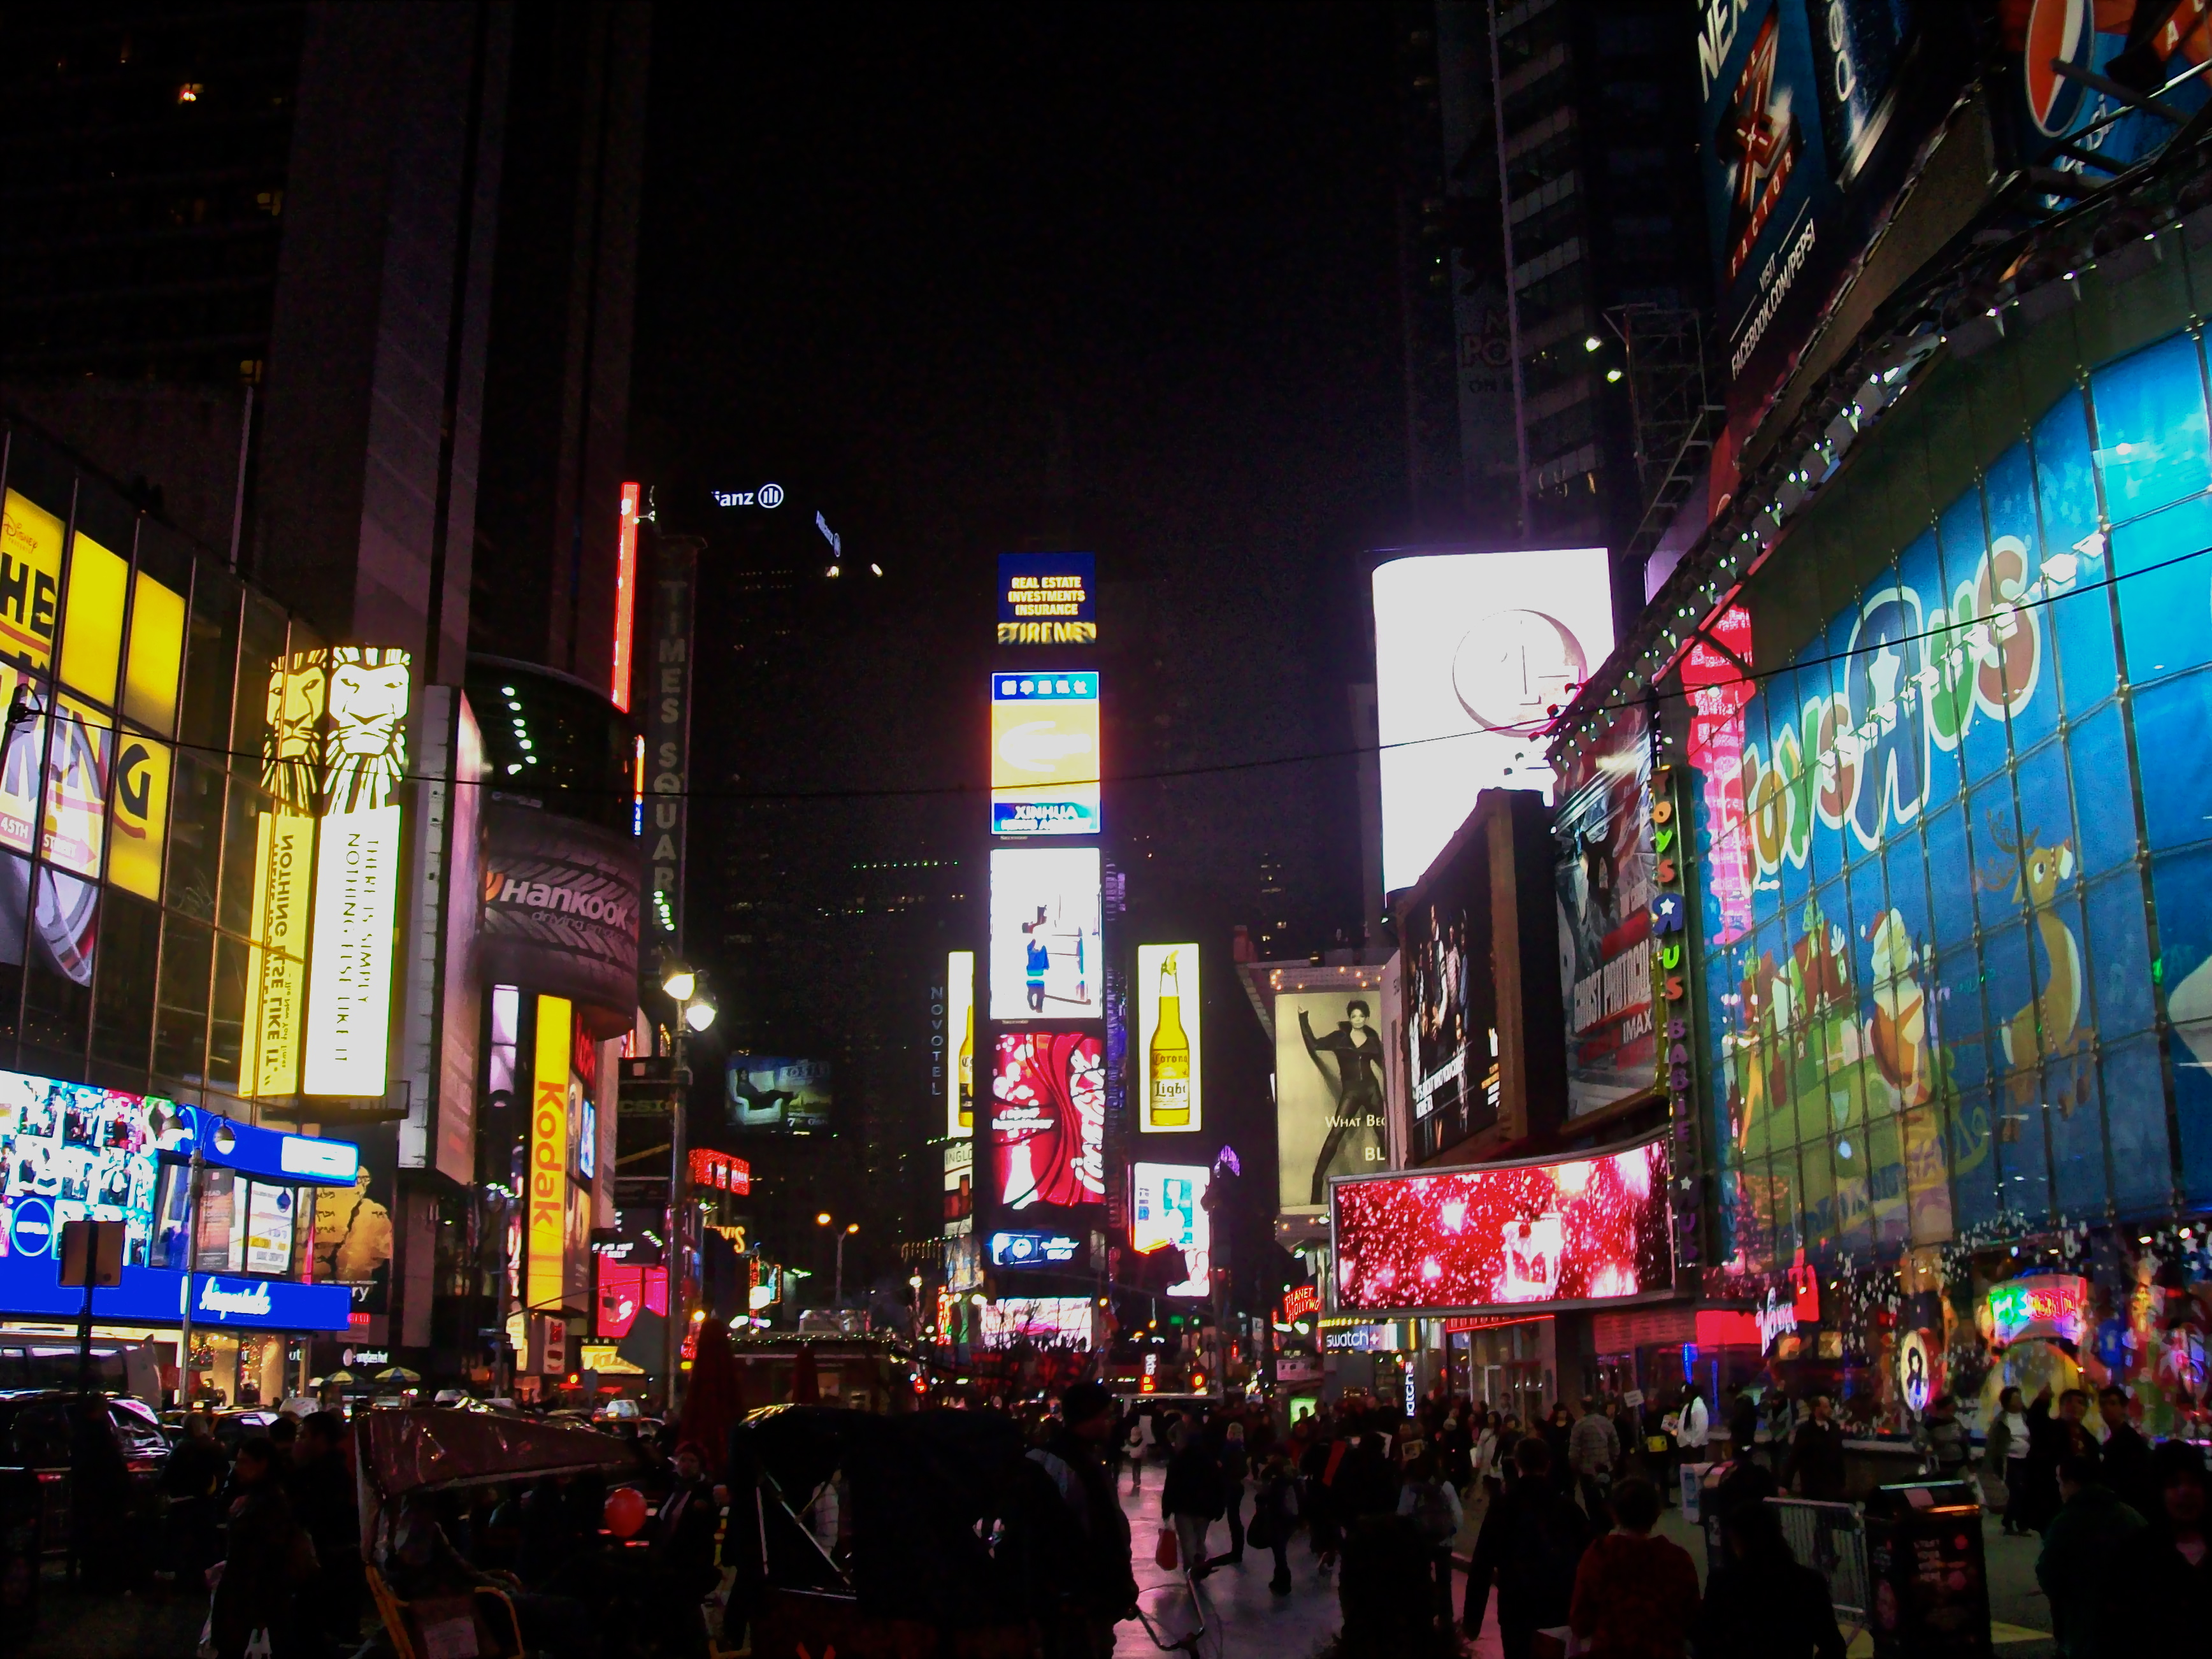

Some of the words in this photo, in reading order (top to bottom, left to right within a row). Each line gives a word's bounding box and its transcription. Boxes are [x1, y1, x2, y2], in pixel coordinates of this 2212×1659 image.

[1732, 150, 1792, 278] FACTOR
[1759, 252, 1776, 292] VISIT
[1012, 576, 1040, 589] REAL
[1041, 575, 1082, 589] ESTATE
[1008, 589, 1086, 603] INVESTMENTS
[1015, 603, 1079, 616] INSURANCE
[1014, 805, 1078, 819] XINHUA
[1, 817, 28, 839] 45TH
[1622, 1008, 1653, 1044] IMAX
[930, 986, 944, 1096] NOVOTEL
[1155, 1080, 1186, 1097] Light
[533, 1081, 565, 1228] Kodak
[1285, 1286, 1314, 1313] PLANET
[1326, 1330, 1369, 1348] swatch
